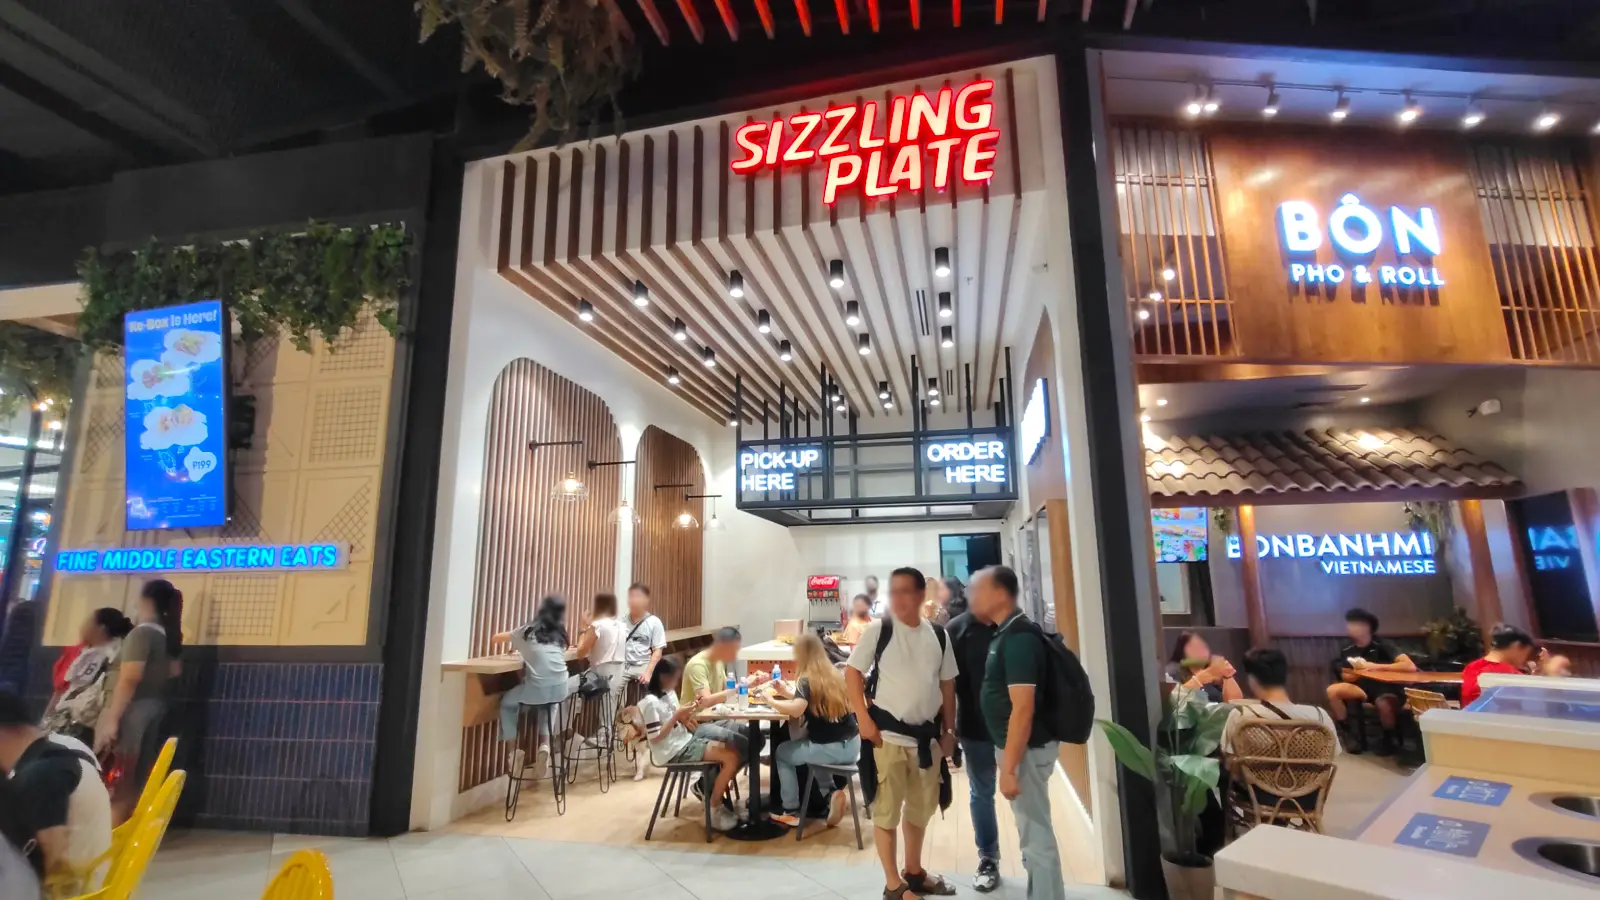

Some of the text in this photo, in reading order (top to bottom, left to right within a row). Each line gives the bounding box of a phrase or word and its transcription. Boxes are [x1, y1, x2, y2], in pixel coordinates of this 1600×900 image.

[731, 79, 995, 171] SIZZLING
[822, 130, 1001, 205] PLATE
[1279, 193, 1442, 256] BÔN
[1290, 263, 1446, 287] PHO & ROLL
[740, 449, 819, 470] PICK-UP
[926, 440, 1005, 462] ORDER
[741, 472, 795, 491] HERE
[945, 464, 1006, 484] HERE
[57, 545, 337, 571] FINE MIDDLE EASTERN EATS
[1321, 559, 1436, 575] VIETNAMESE
